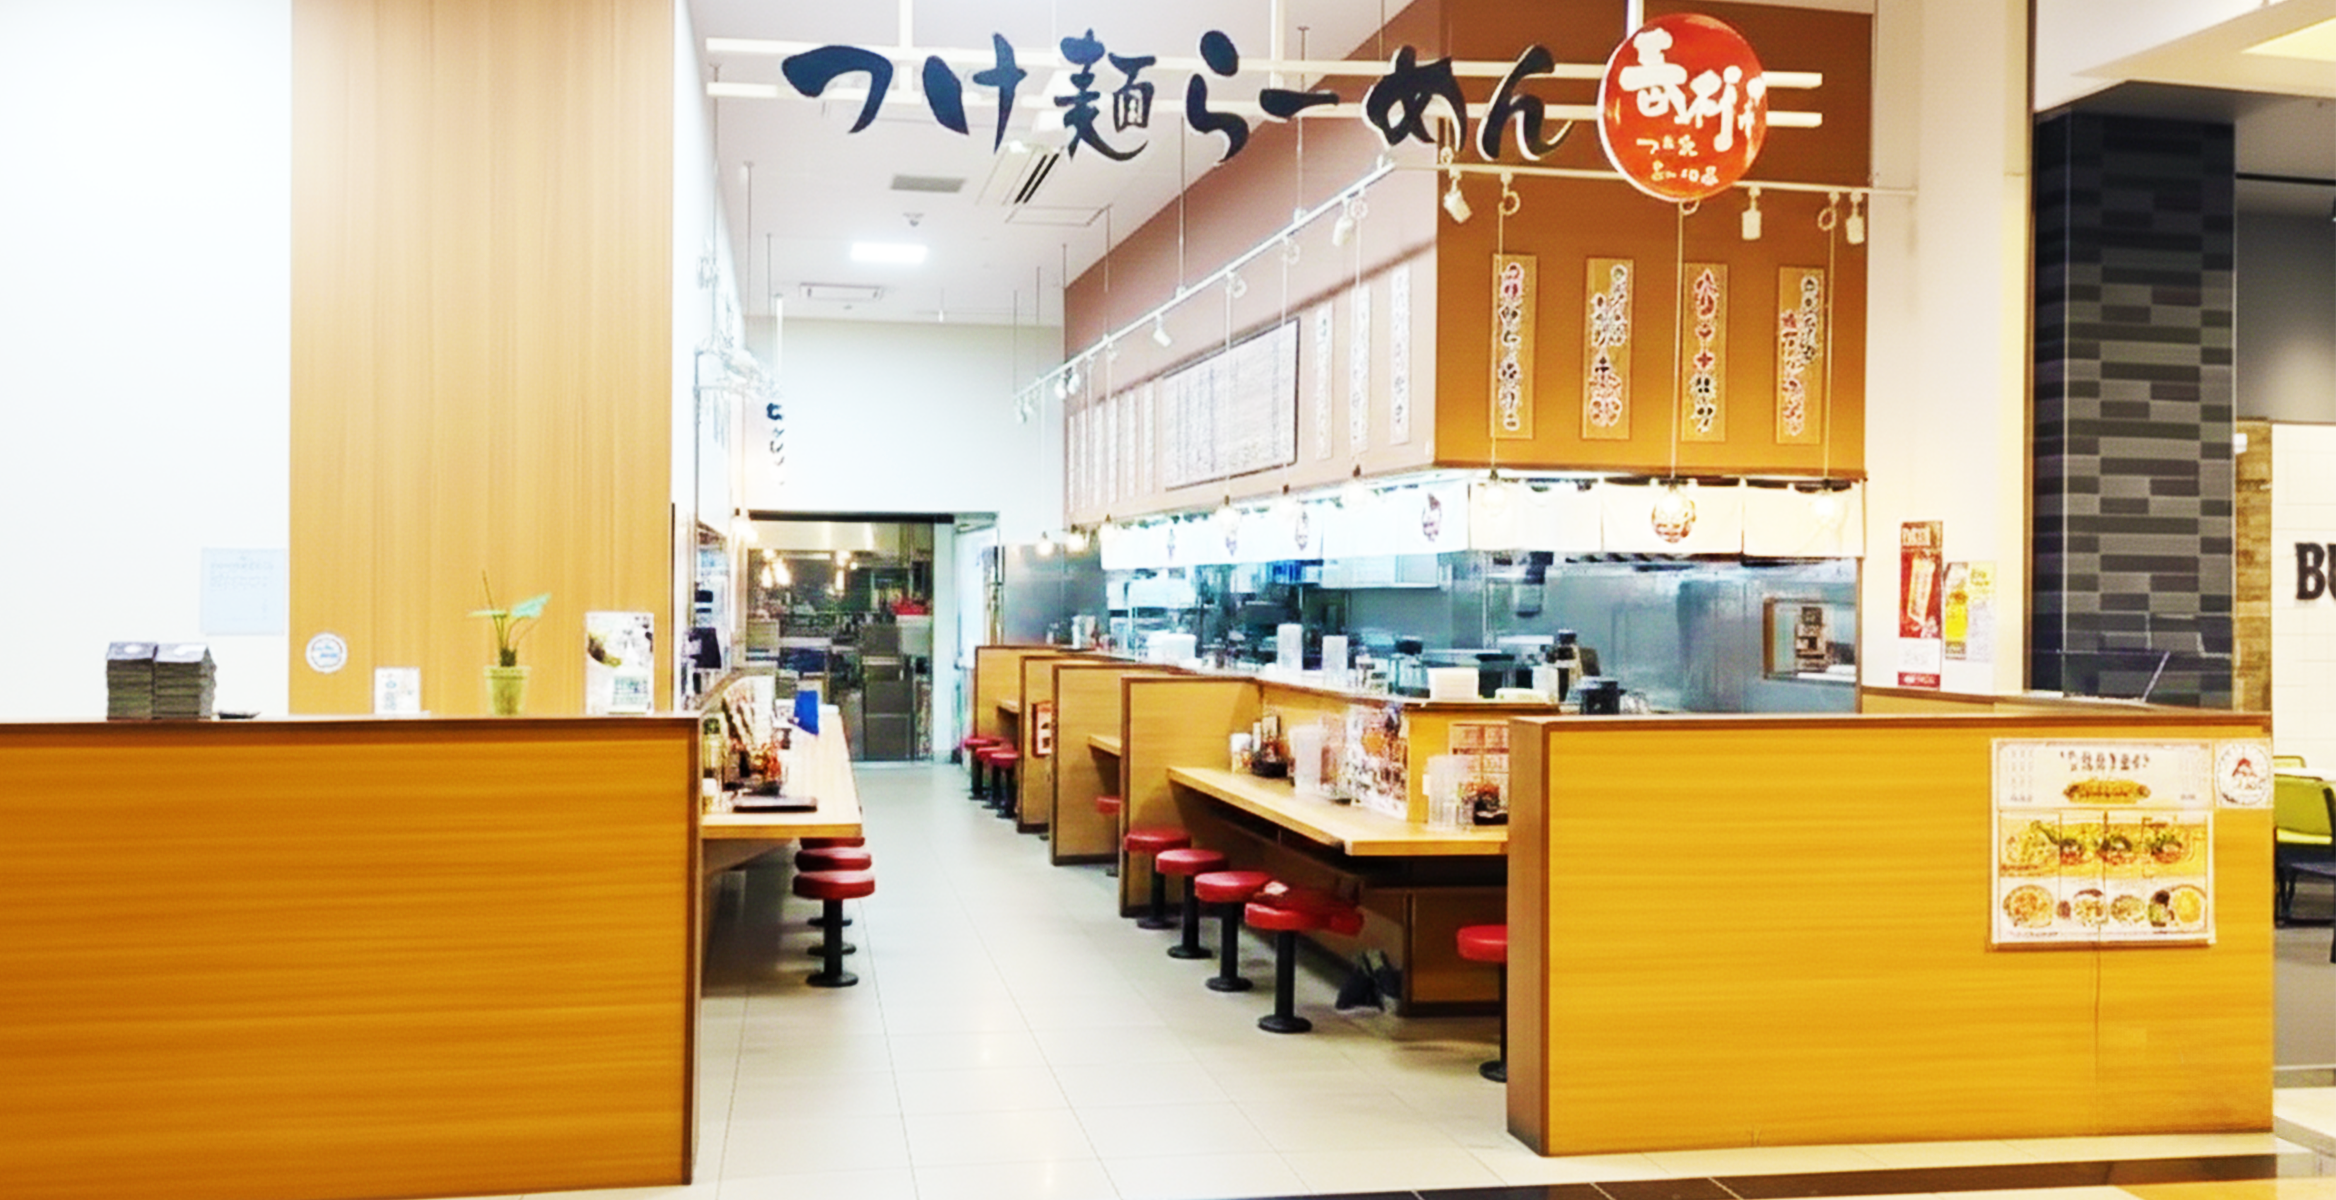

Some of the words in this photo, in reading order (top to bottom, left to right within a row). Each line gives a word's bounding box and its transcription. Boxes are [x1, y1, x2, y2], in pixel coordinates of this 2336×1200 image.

[781, 29, 1574, 162] つけ麺らーめん
